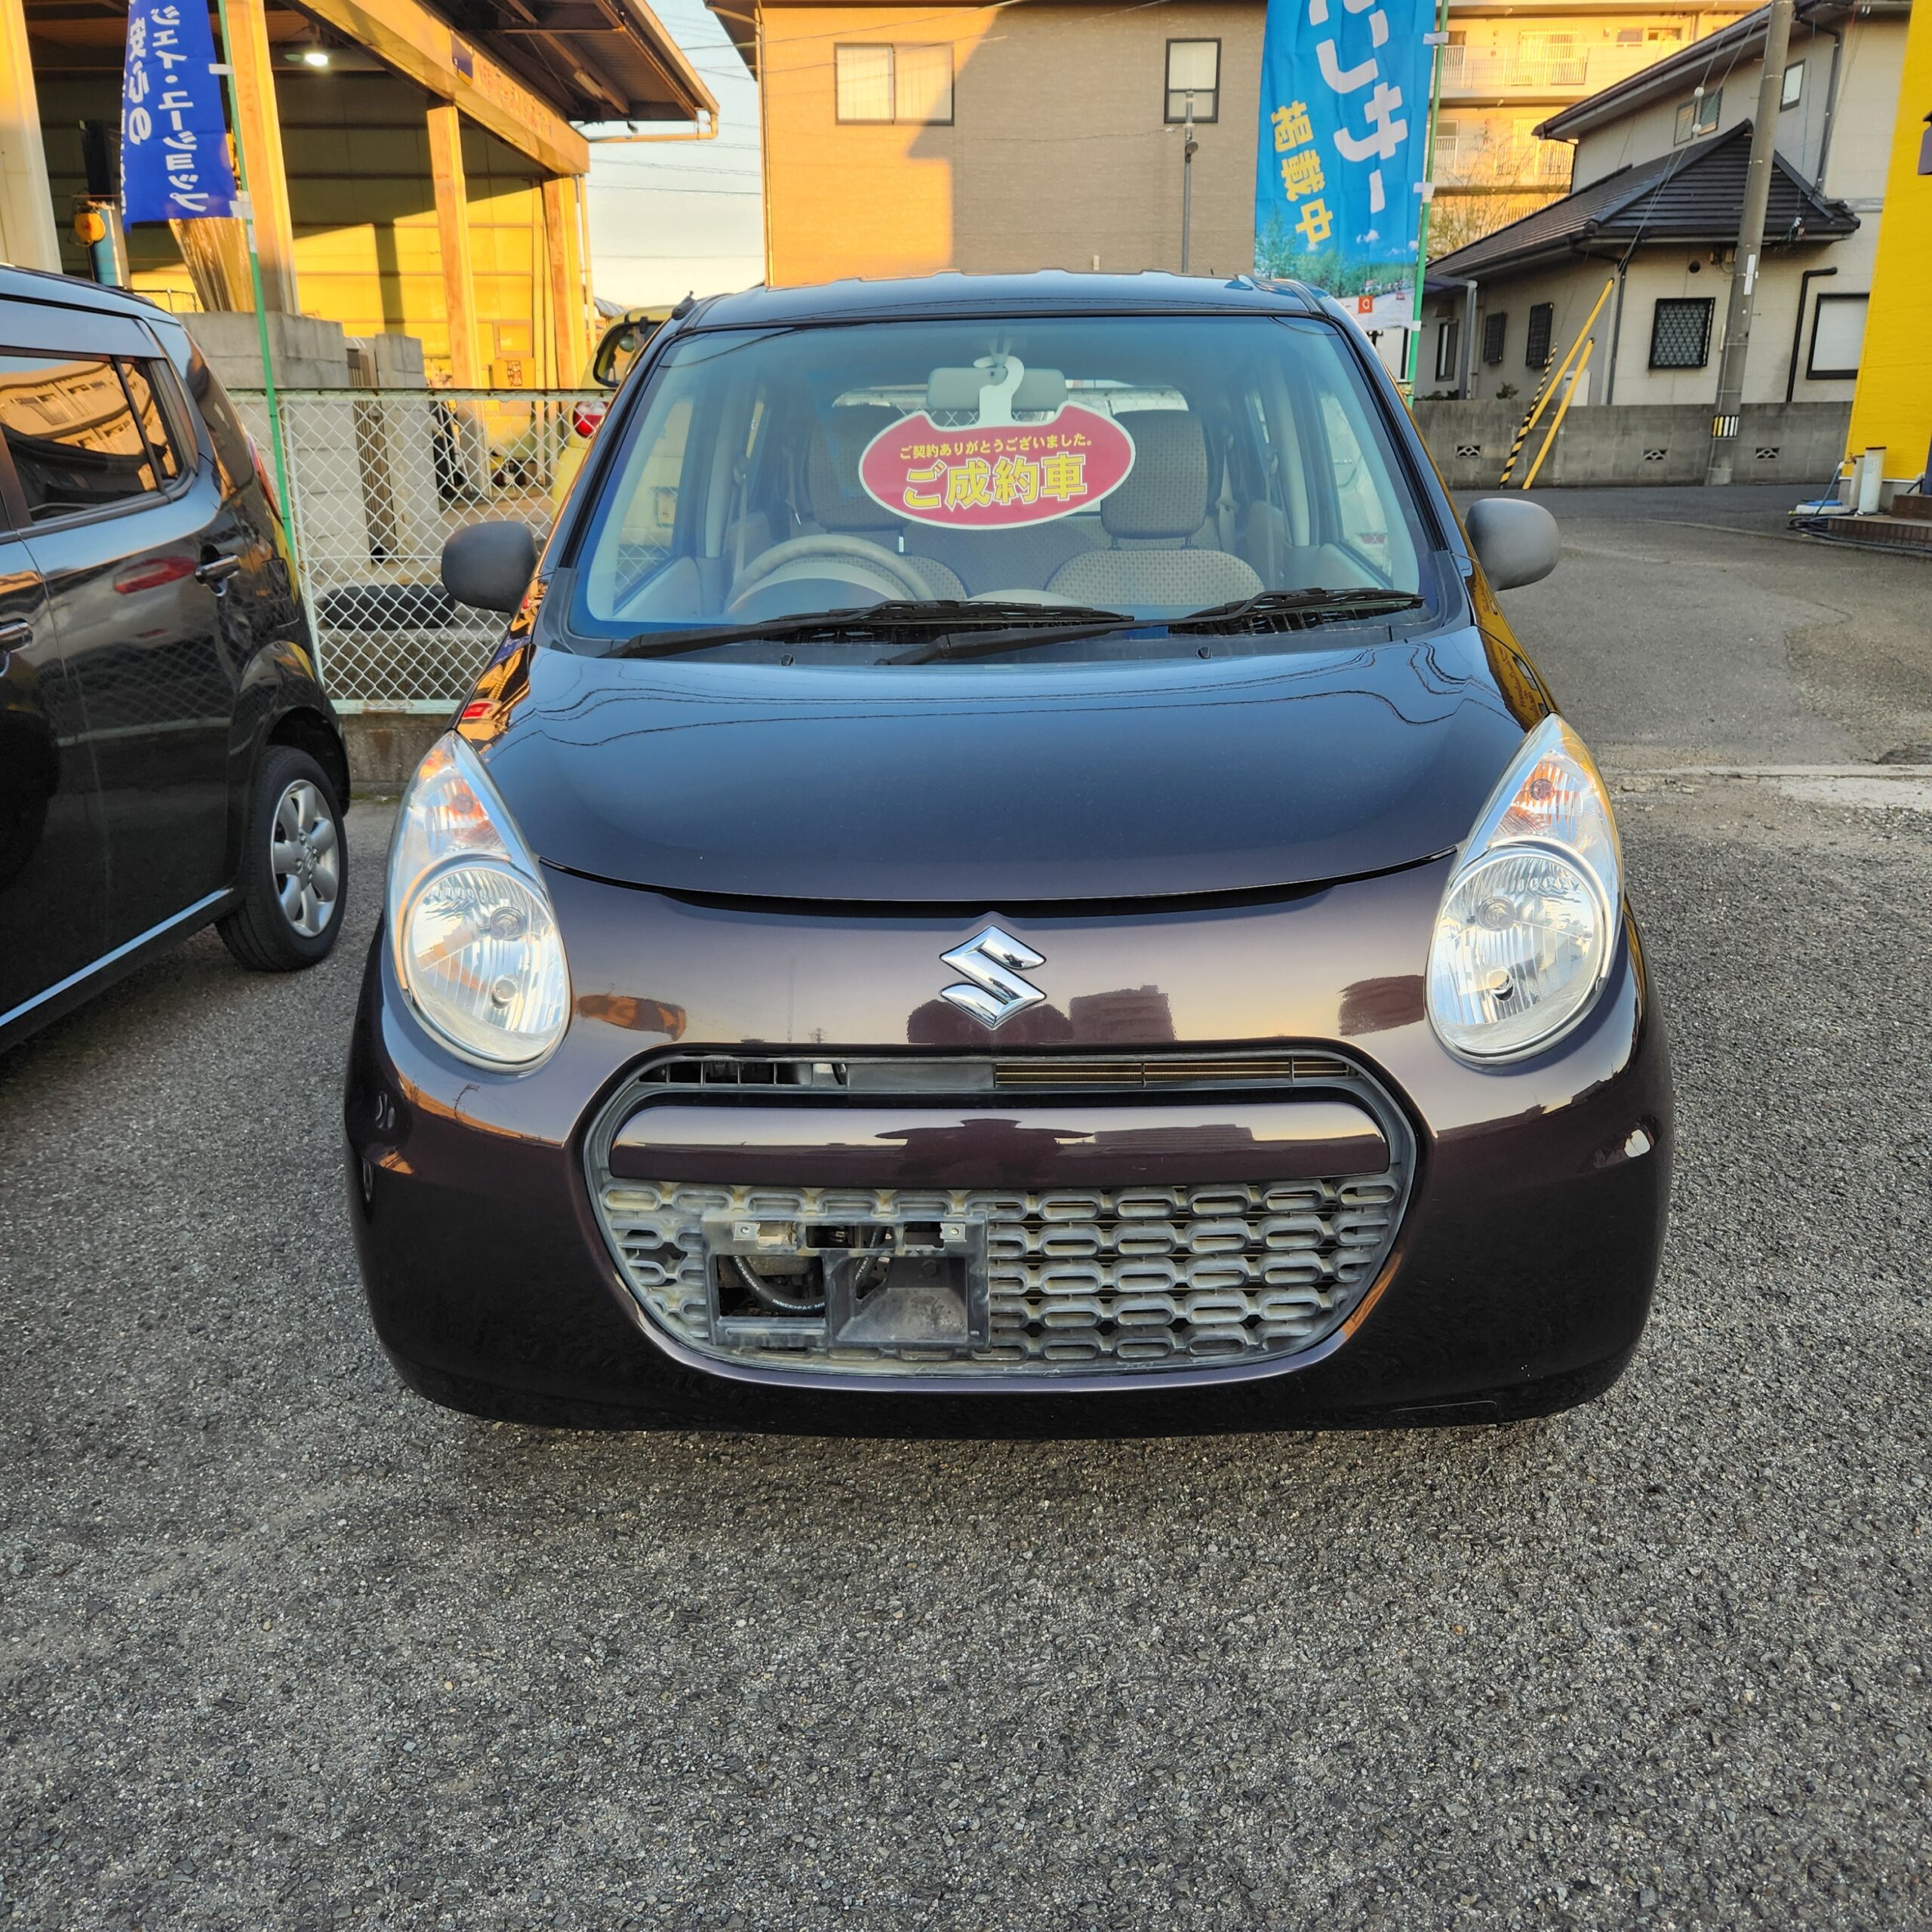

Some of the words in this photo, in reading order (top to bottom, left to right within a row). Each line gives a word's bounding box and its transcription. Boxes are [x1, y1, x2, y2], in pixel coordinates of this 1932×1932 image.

[1271, 100, 1334, 245] 掲載中
[900, 432, 1093, 460] ご契約ありがとうございました。
[903, 451, 1088, 512] ご成約車
